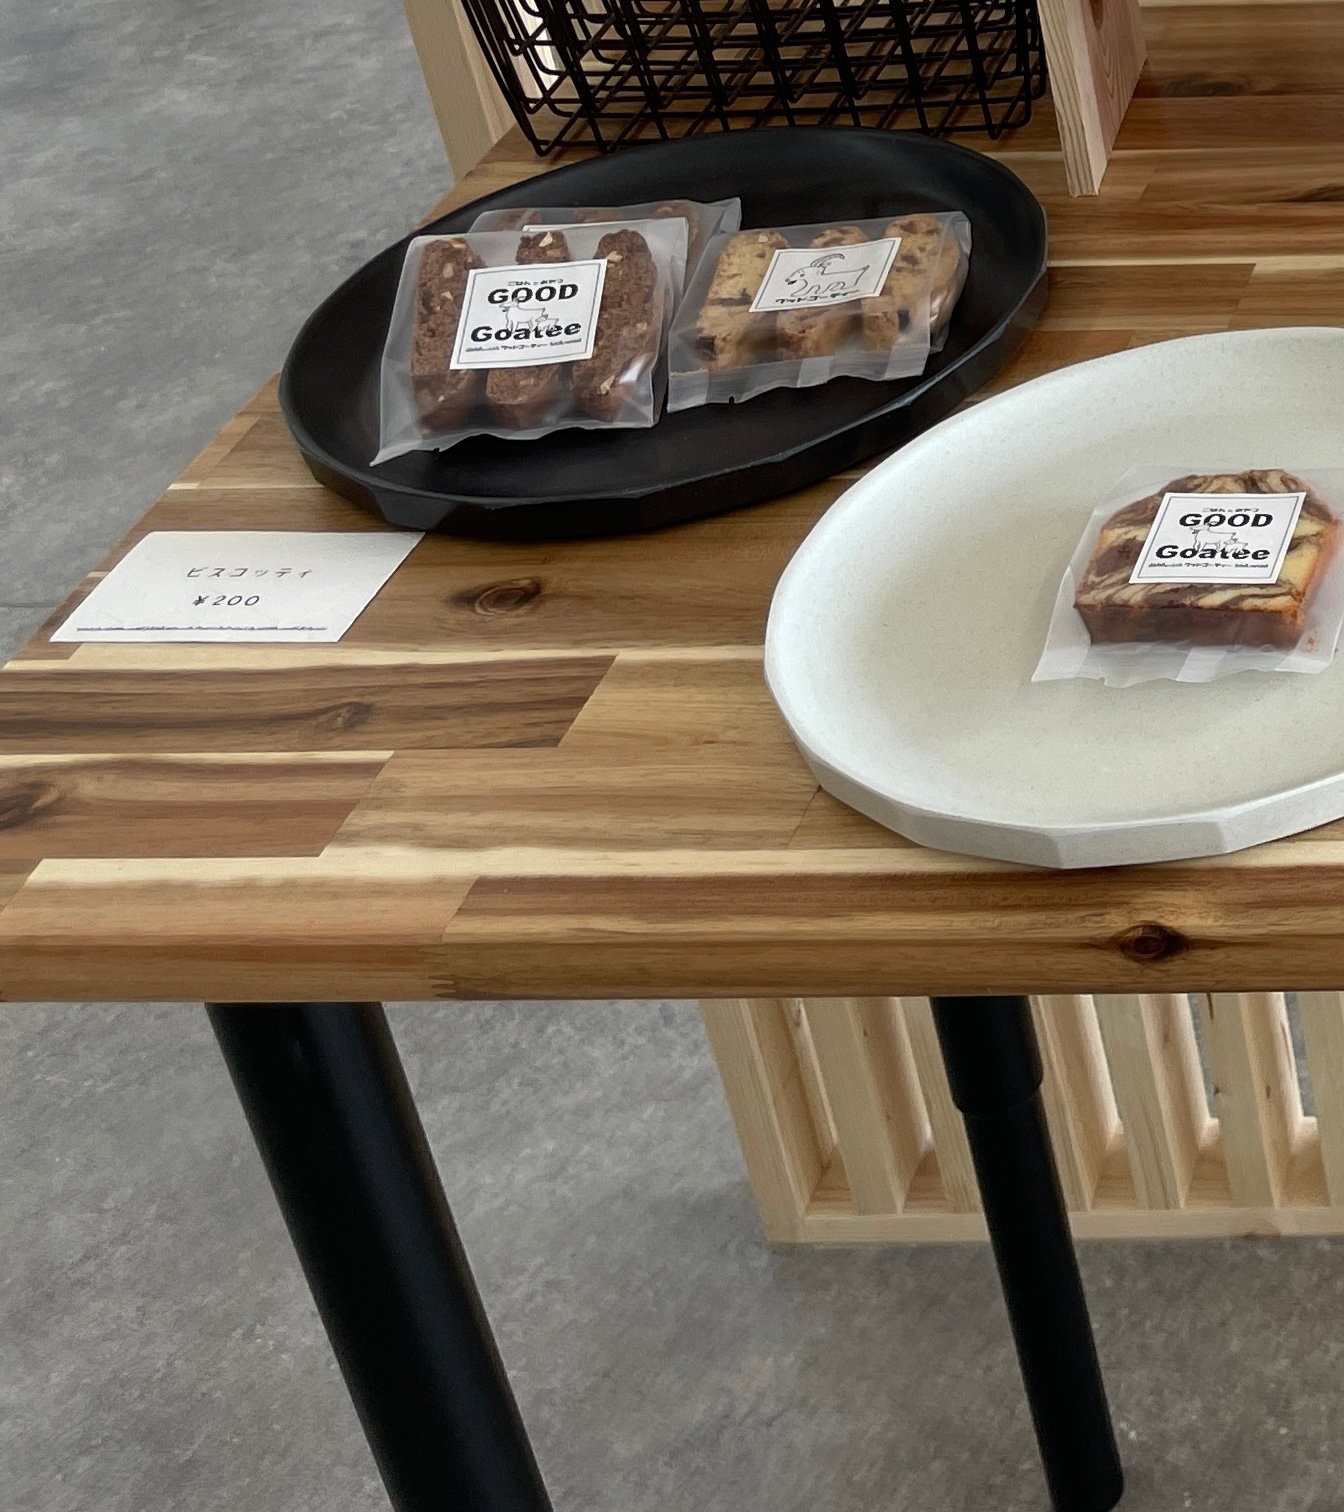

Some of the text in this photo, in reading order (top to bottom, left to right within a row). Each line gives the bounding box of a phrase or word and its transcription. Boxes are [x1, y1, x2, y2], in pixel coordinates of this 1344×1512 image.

[487, 283, 579, 304] GOOD
[471, 322, 582, 342] Goatee
[1179, 513, 1274, 528] GOOD
[1155, 544, 1271, 560] Goatee
[187, 567, 312, 578] ビスコッティ
[192, 595, 260, 606] ¥200
